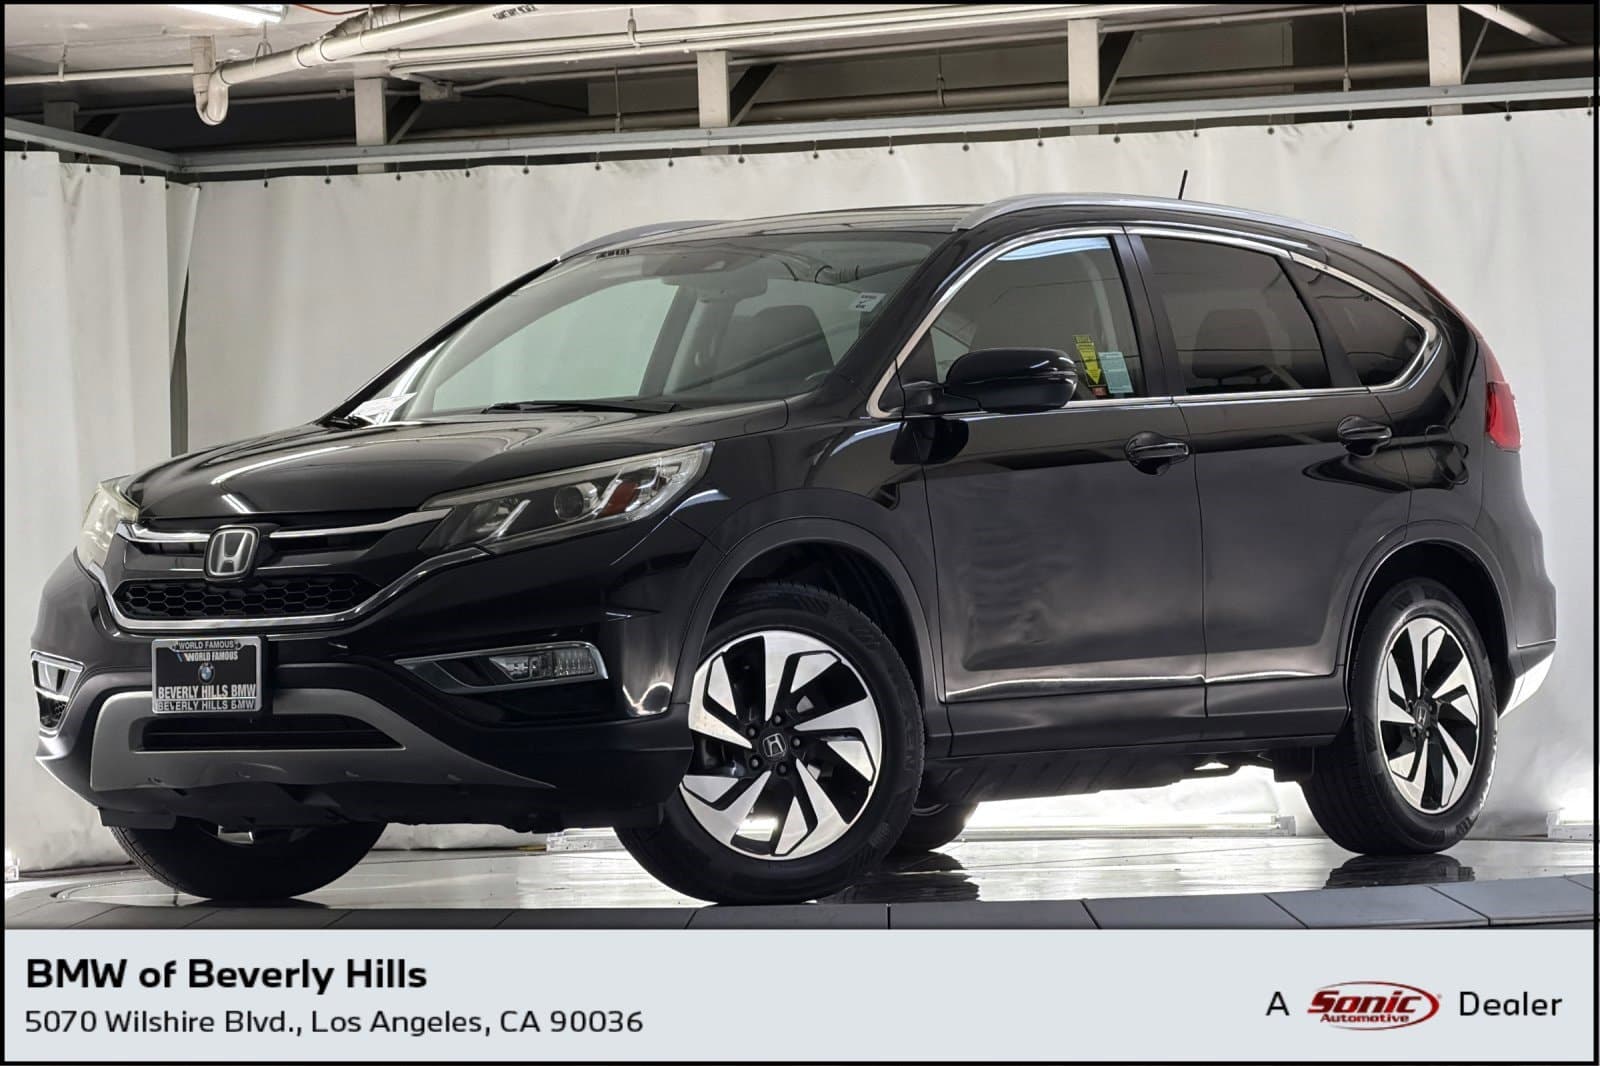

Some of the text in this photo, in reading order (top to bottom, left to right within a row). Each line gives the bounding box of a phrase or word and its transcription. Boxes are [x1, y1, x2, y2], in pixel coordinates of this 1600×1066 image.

[178, 640, 234, 650] WORLD FAMOUS
[186, 651, 238, 662] WORLD FAMOUS
[158, 684, 257, 699] BEVERLY HILLS BMW
[158, 699, 256, 711] BEVERLY HILLS BMW
